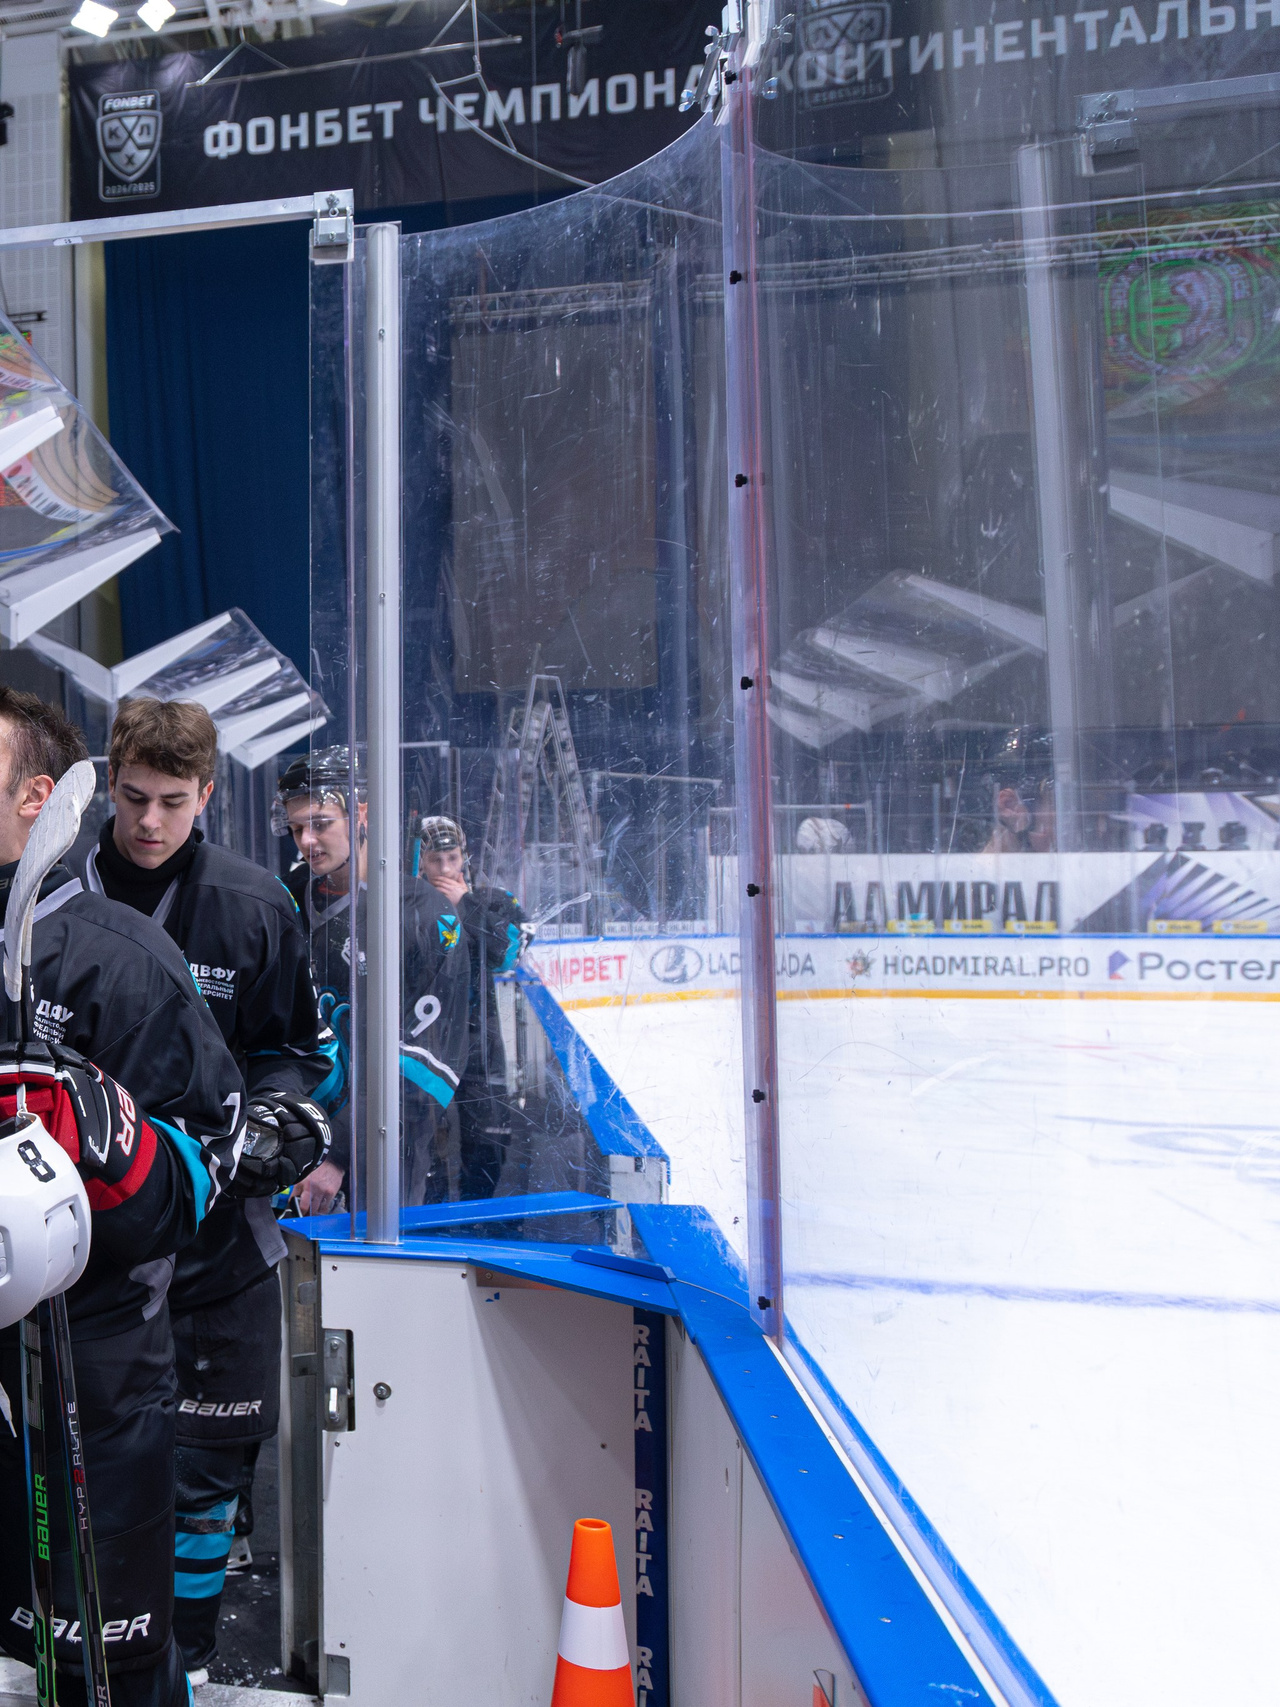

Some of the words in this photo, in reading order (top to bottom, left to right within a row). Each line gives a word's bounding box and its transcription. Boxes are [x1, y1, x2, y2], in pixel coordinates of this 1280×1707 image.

[104, 95, 155, 111] FONBET
[204, 101, 404, 159] ФОНБЕТ
[190, 963, 236, 982] ДВФУ
[883, 954, 1090, 978] HCADMIRAL.PRO
[17, 1139, 56, 1183] 8
[633, 1324, 653, 1432] RAITA
[178, 1398, 262, 1417] BAUER
[34, 1473, 50, 1561] BAUER
[635, 1488, 654, 1597] RAITA
